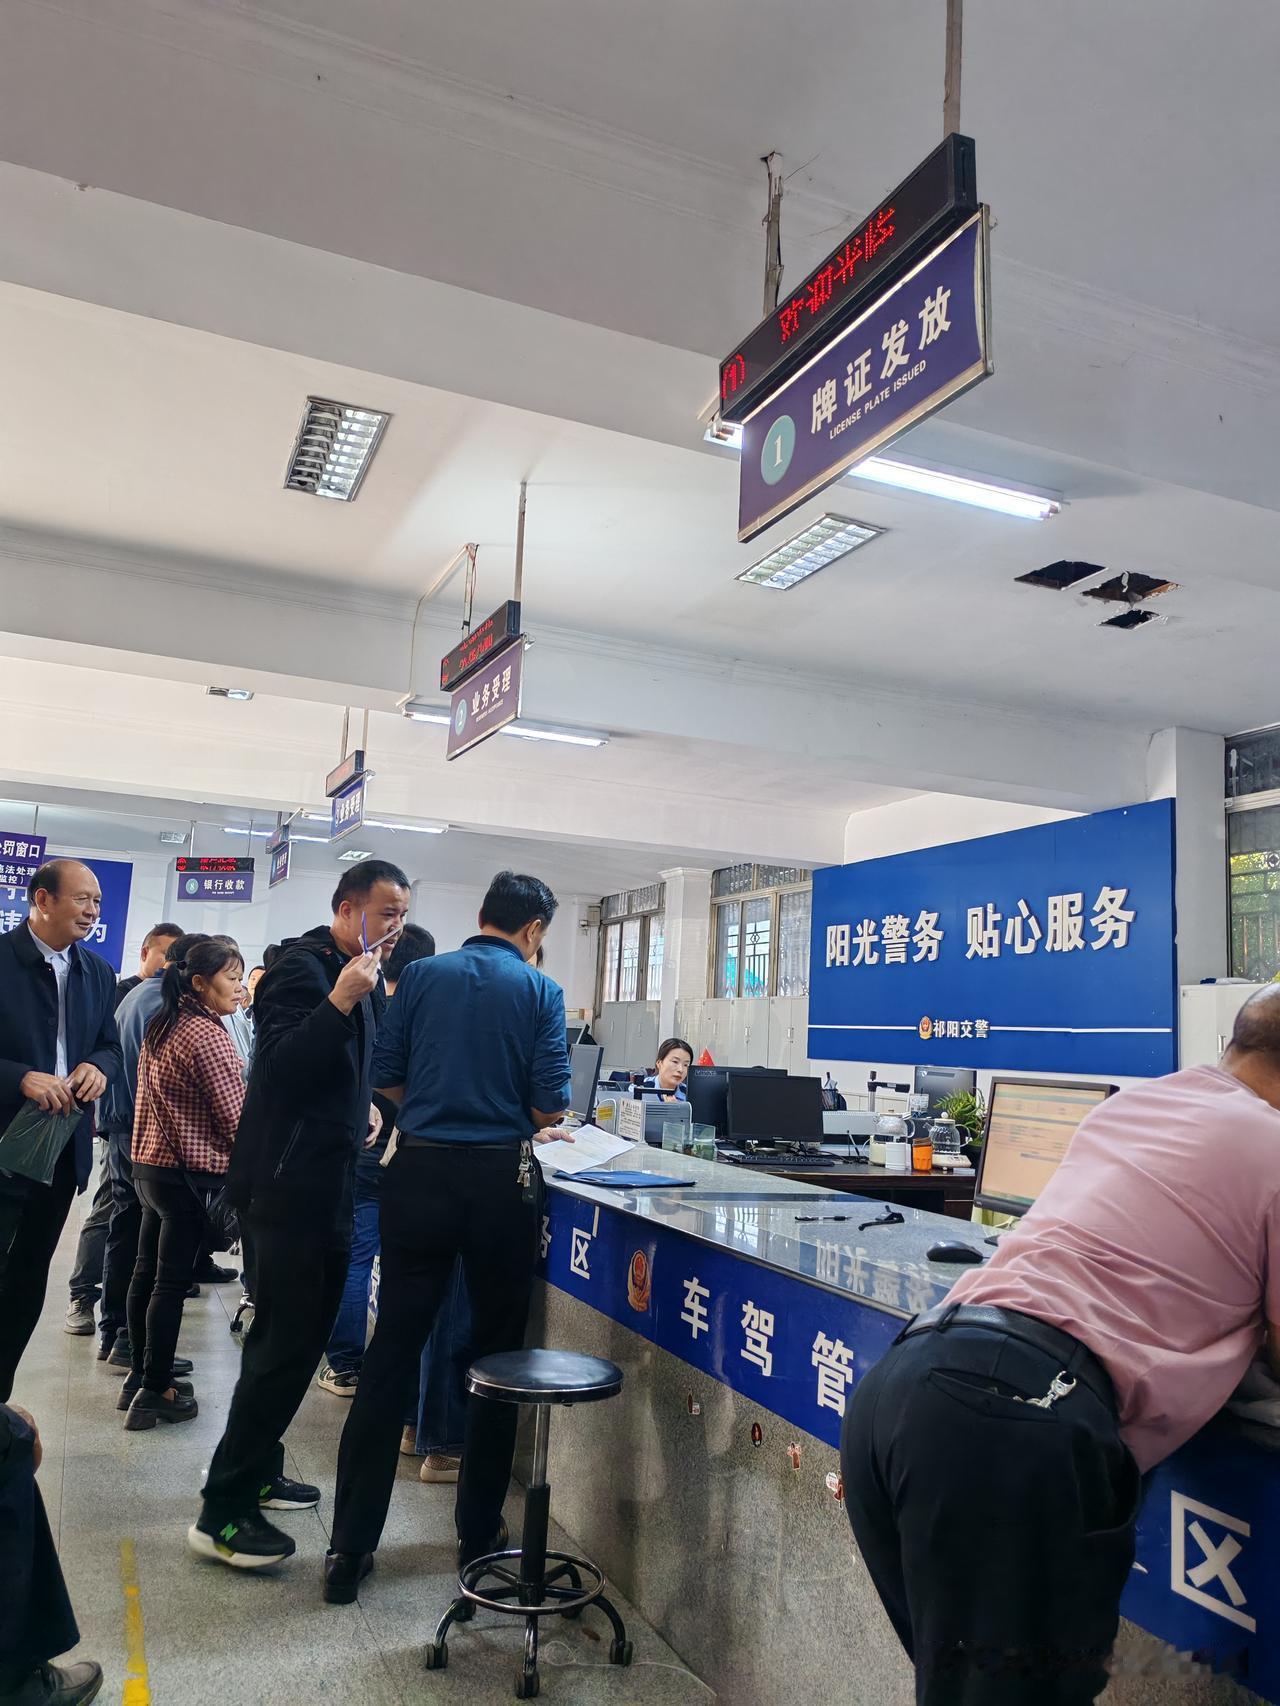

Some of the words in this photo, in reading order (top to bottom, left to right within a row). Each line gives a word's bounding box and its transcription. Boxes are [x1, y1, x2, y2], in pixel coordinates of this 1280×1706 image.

[811, 285, 951, 434] 牌证发放
[829, 408, 862, 440] LICENSE
[864, 386, 890, 414] PLATE
[893, 359, 927, 392] ISSUED
[773, 434, 783, 468] 1
[471, 664, 512, 716] 业务受理
[0, 839, 41, 858] 罚窗口
[203, 879, 246, 891] 银行收款
[825, 909, 945, 968] 阳光警务
[965, 886, 1136, 961] 贴心服务
[933, 1019, 989, 1039] 祁阳交警
[681, 1276, 854, 1418] 车驾管
[1170, 1489, 1257, 1634] 区
